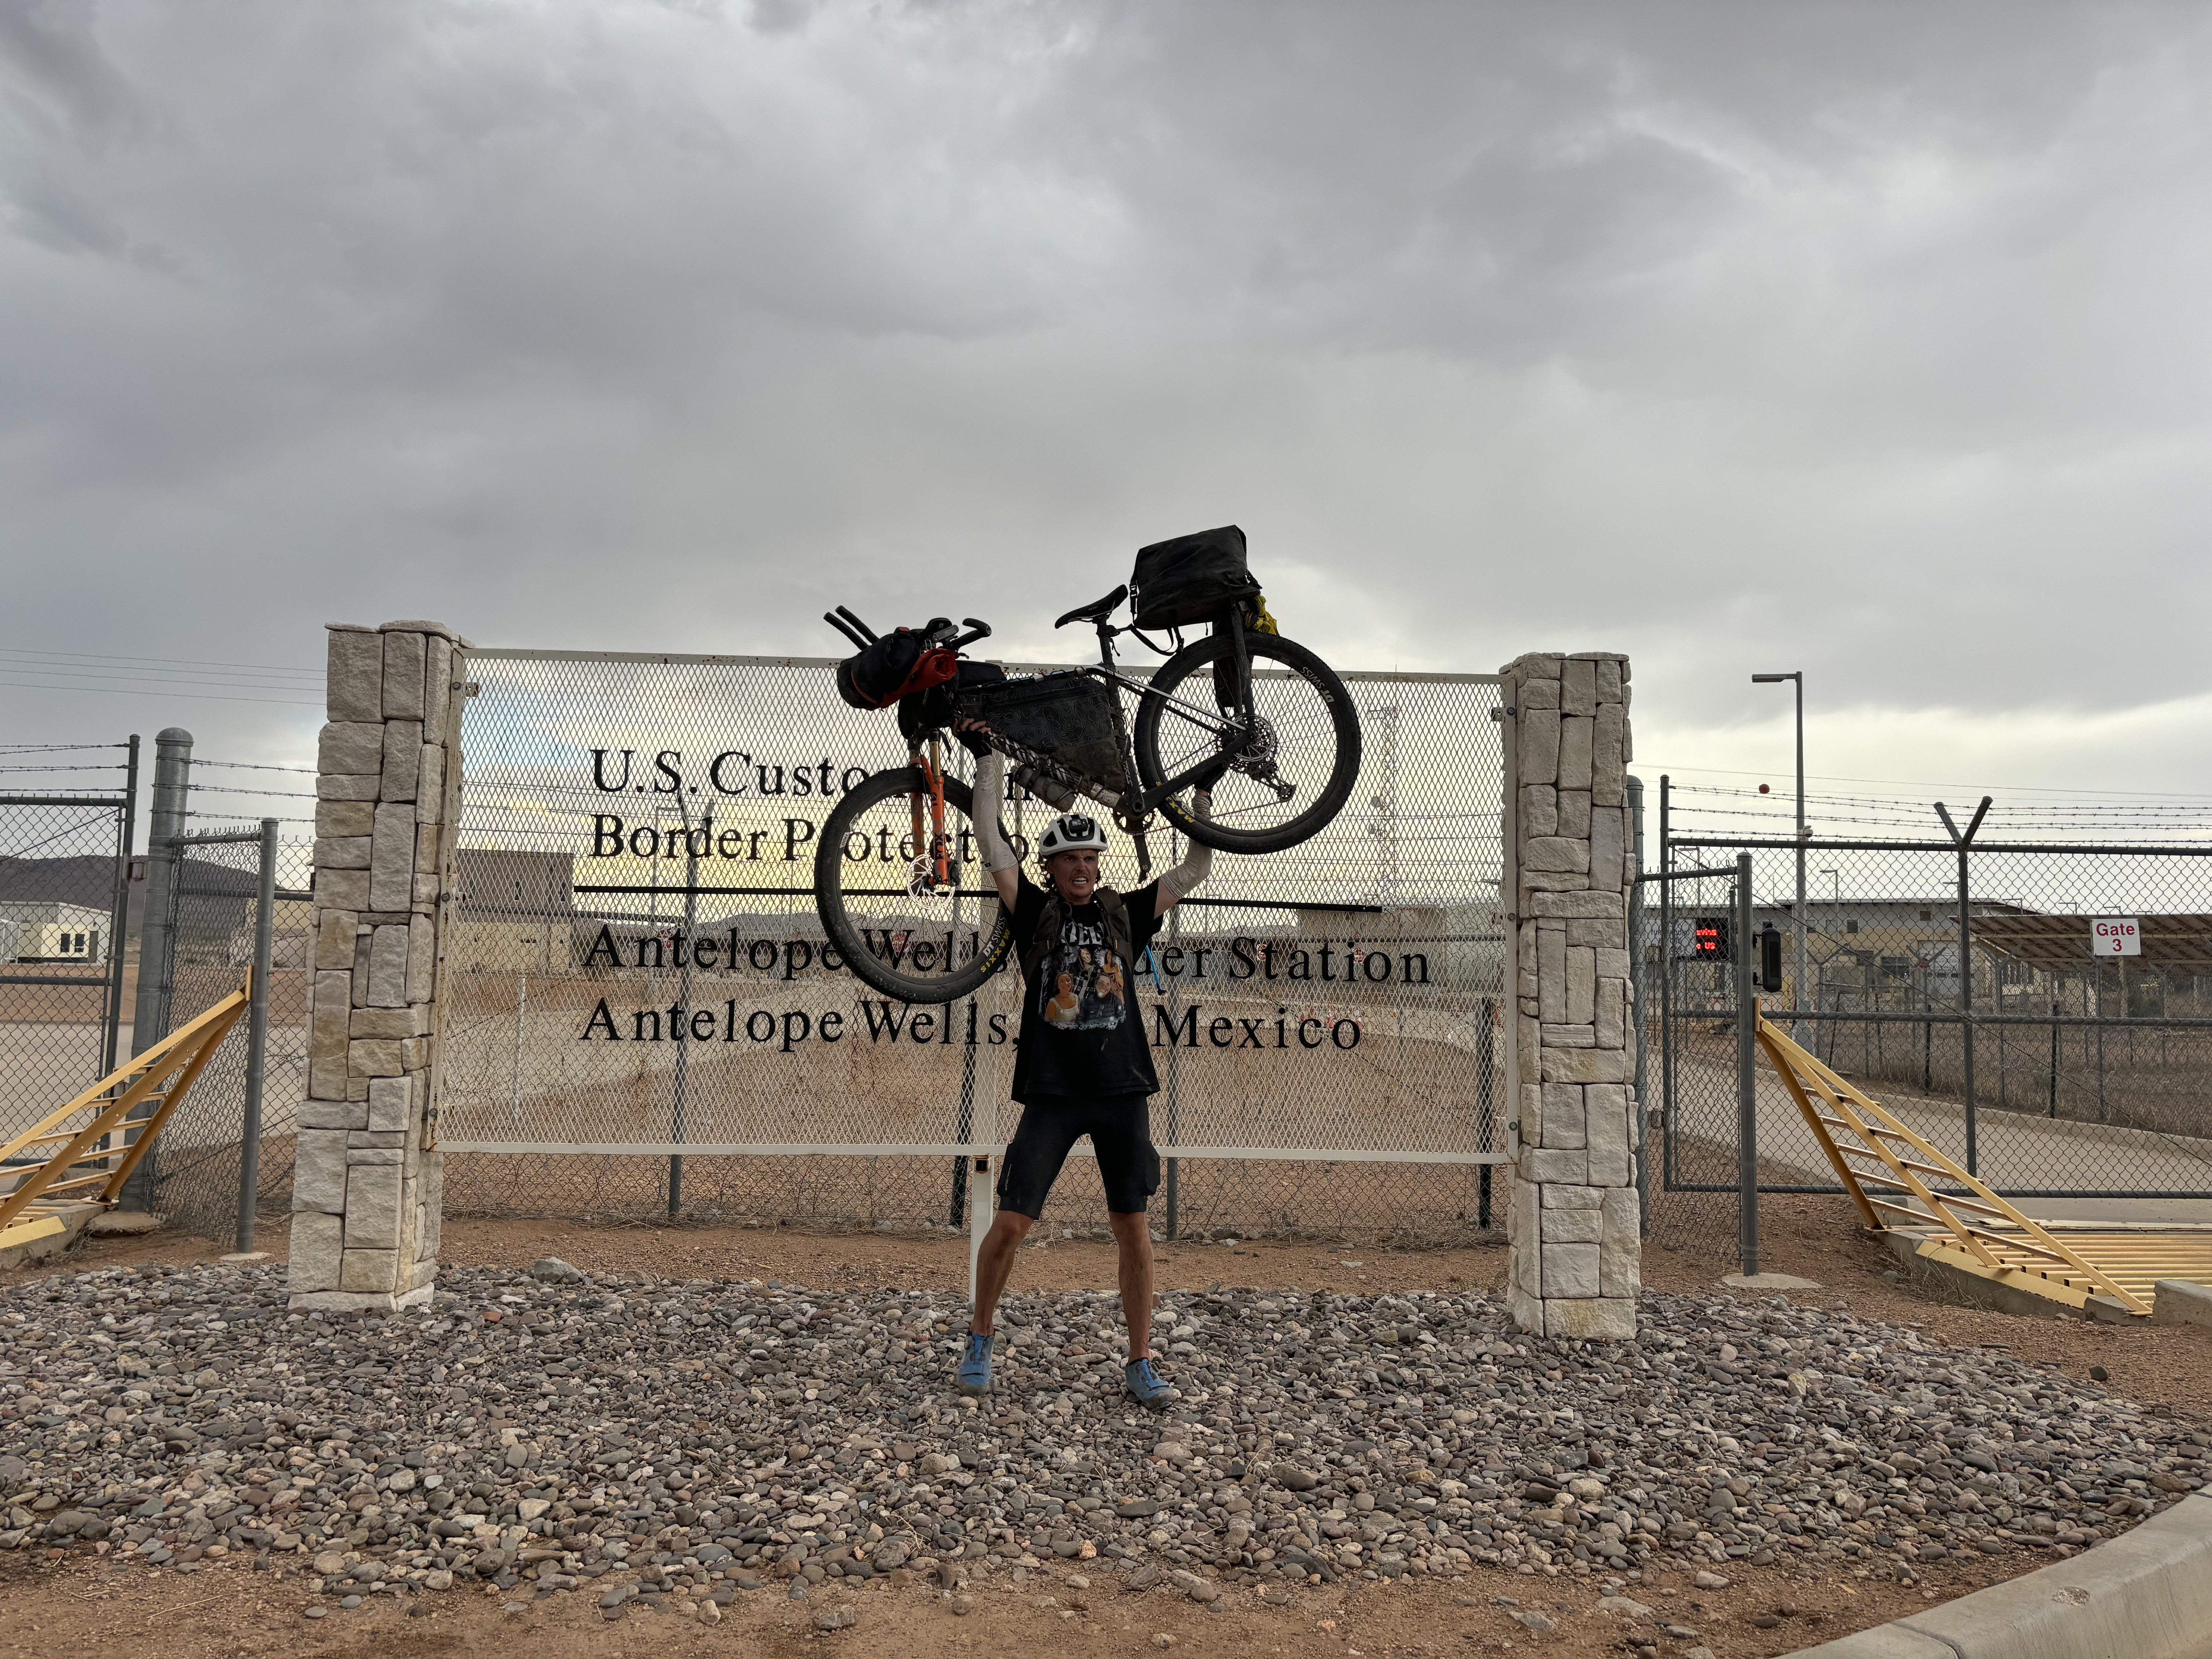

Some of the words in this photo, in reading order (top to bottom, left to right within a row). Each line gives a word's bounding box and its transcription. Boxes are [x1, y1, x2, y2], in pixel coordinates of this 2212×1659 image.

[1300, 667, 1325, 689] SWISS
[1319, 690, 1335, 703] DT
[590, 749, 697, 793] U.S.
[588, 814, 769, 860] Border
[980, 929, 1011, 973] MAXXIS
[982, 941, 994, 958] DT
[992, 916, 1006, 943] SWISS
[2096, 923, 2135, 936] Gate
[2112, 939, 2123, 952] 3
[582, 925, 845, 980] Antelope
[860, 928, 1008, 974] Well
[1229, 936, 1431, 984] Station
[579, 997, 844, 1053] Antelope
[857, 1000, 1018, 1052] Wells,
[1151, 1005, 1361, 1049] Mexico
